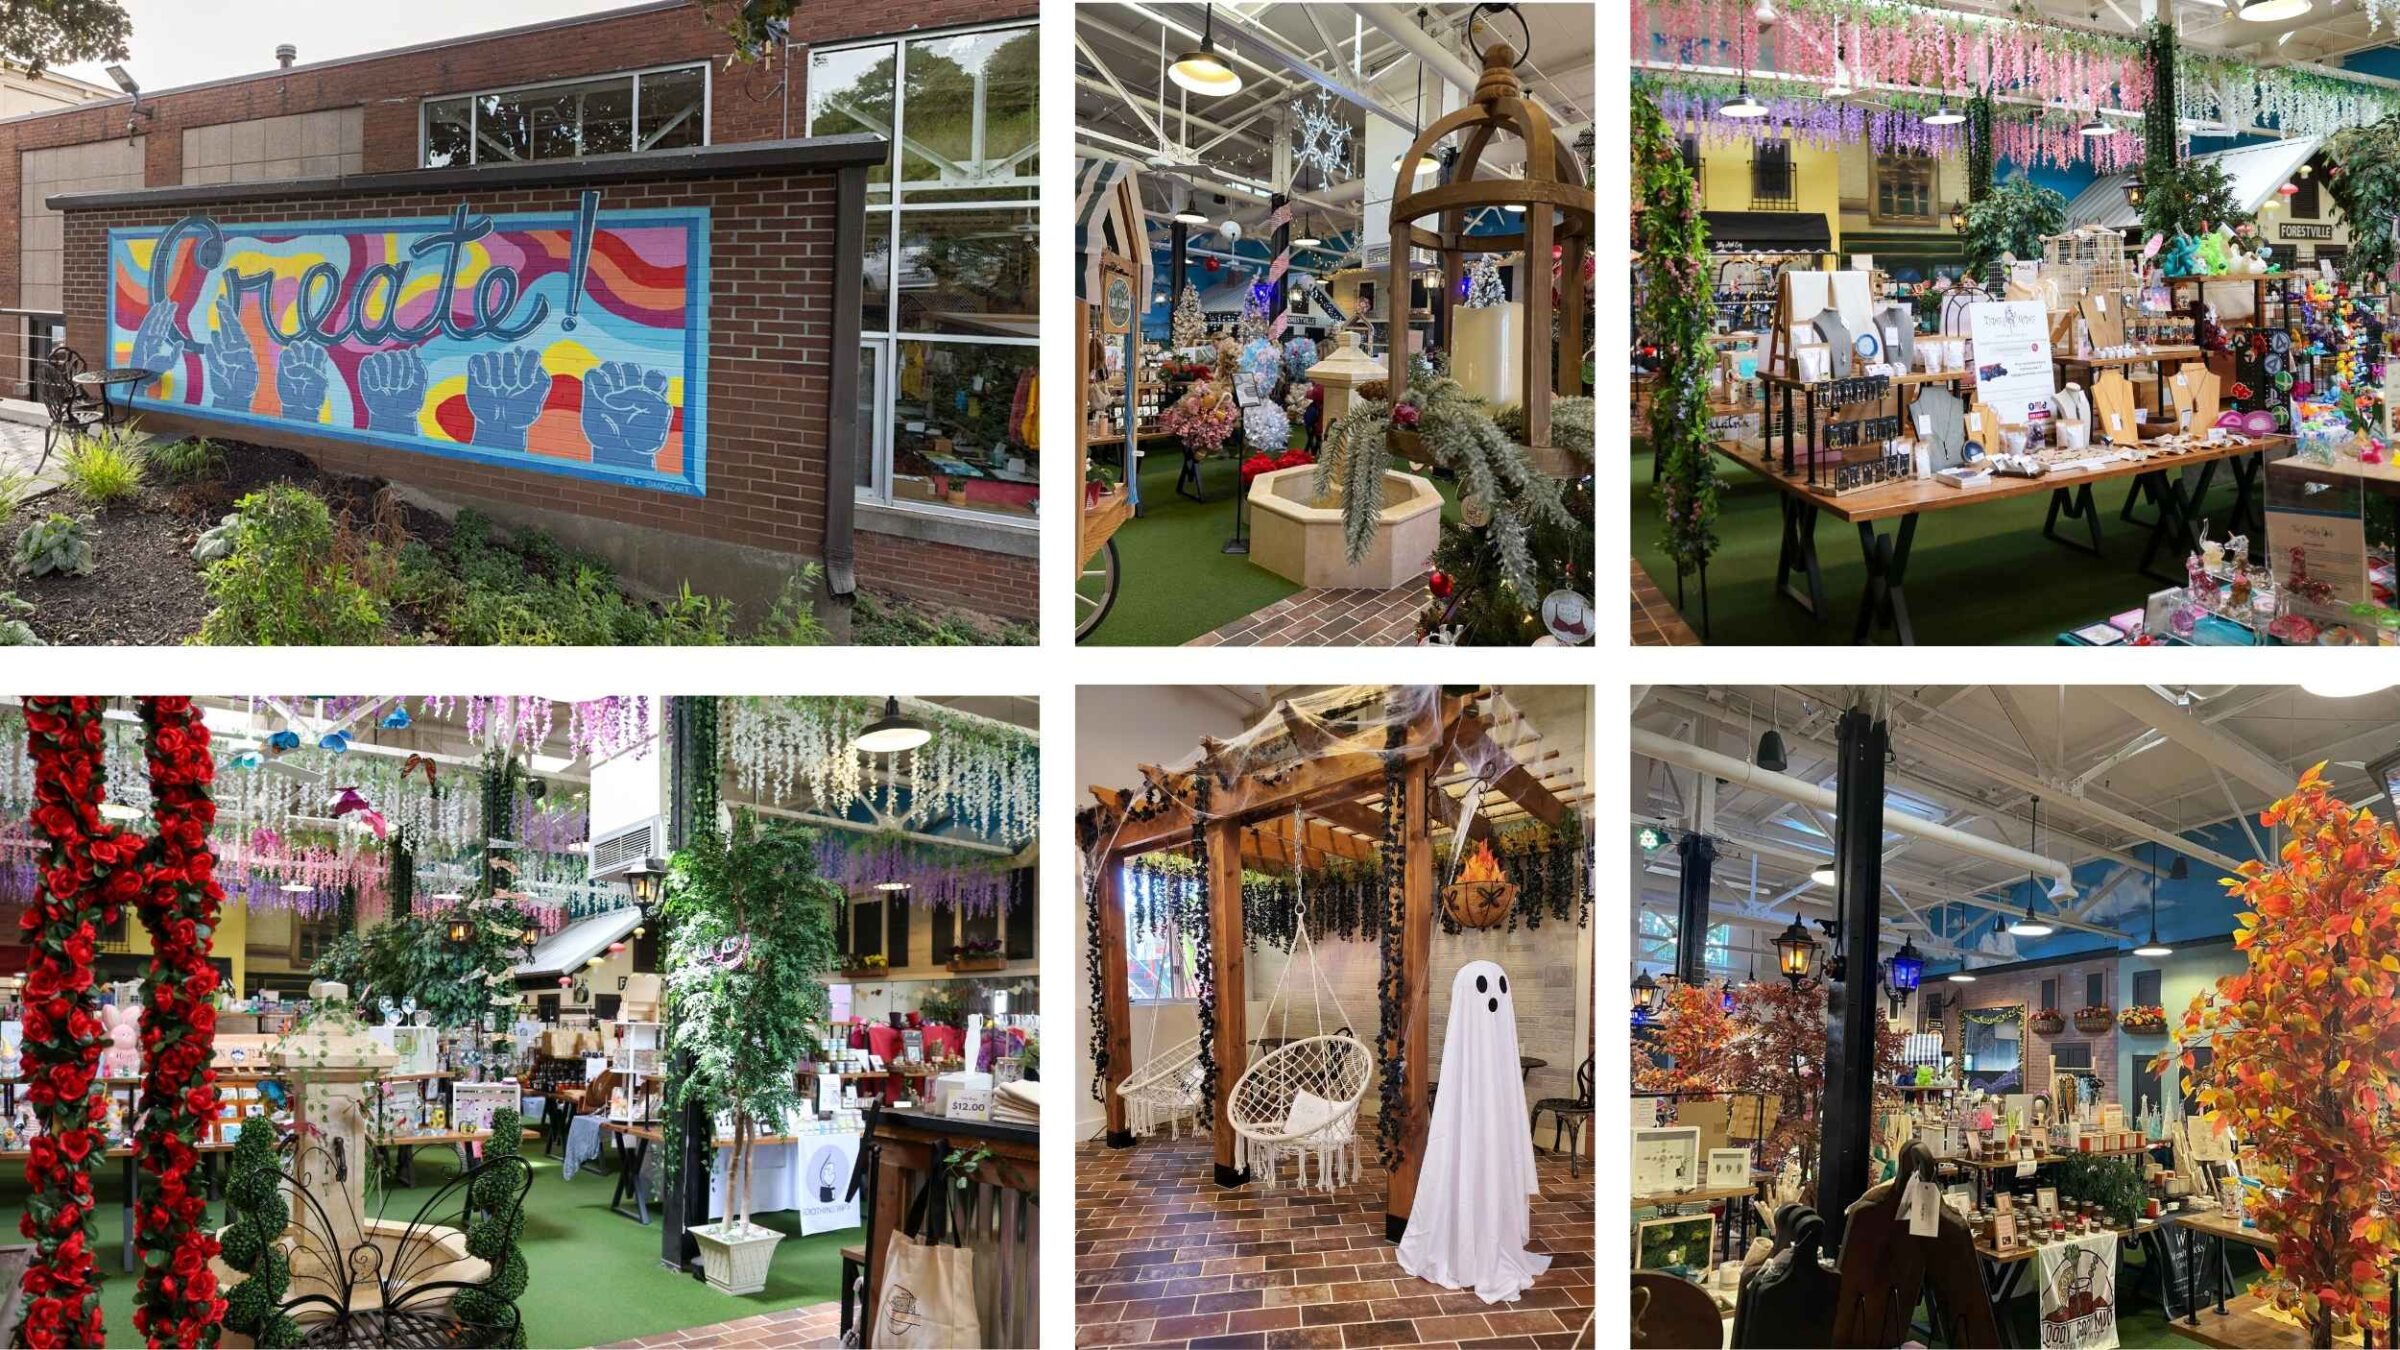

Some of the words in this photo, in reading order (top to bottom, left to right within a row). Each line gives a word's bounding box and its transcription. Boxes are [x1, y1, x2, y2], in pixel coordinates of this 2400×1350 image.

[2281, 225, 2331, 238] FORESTVILLE
[150, 190, 600, 354] Create!
[952, 1101, 985, 1111] $12.00
